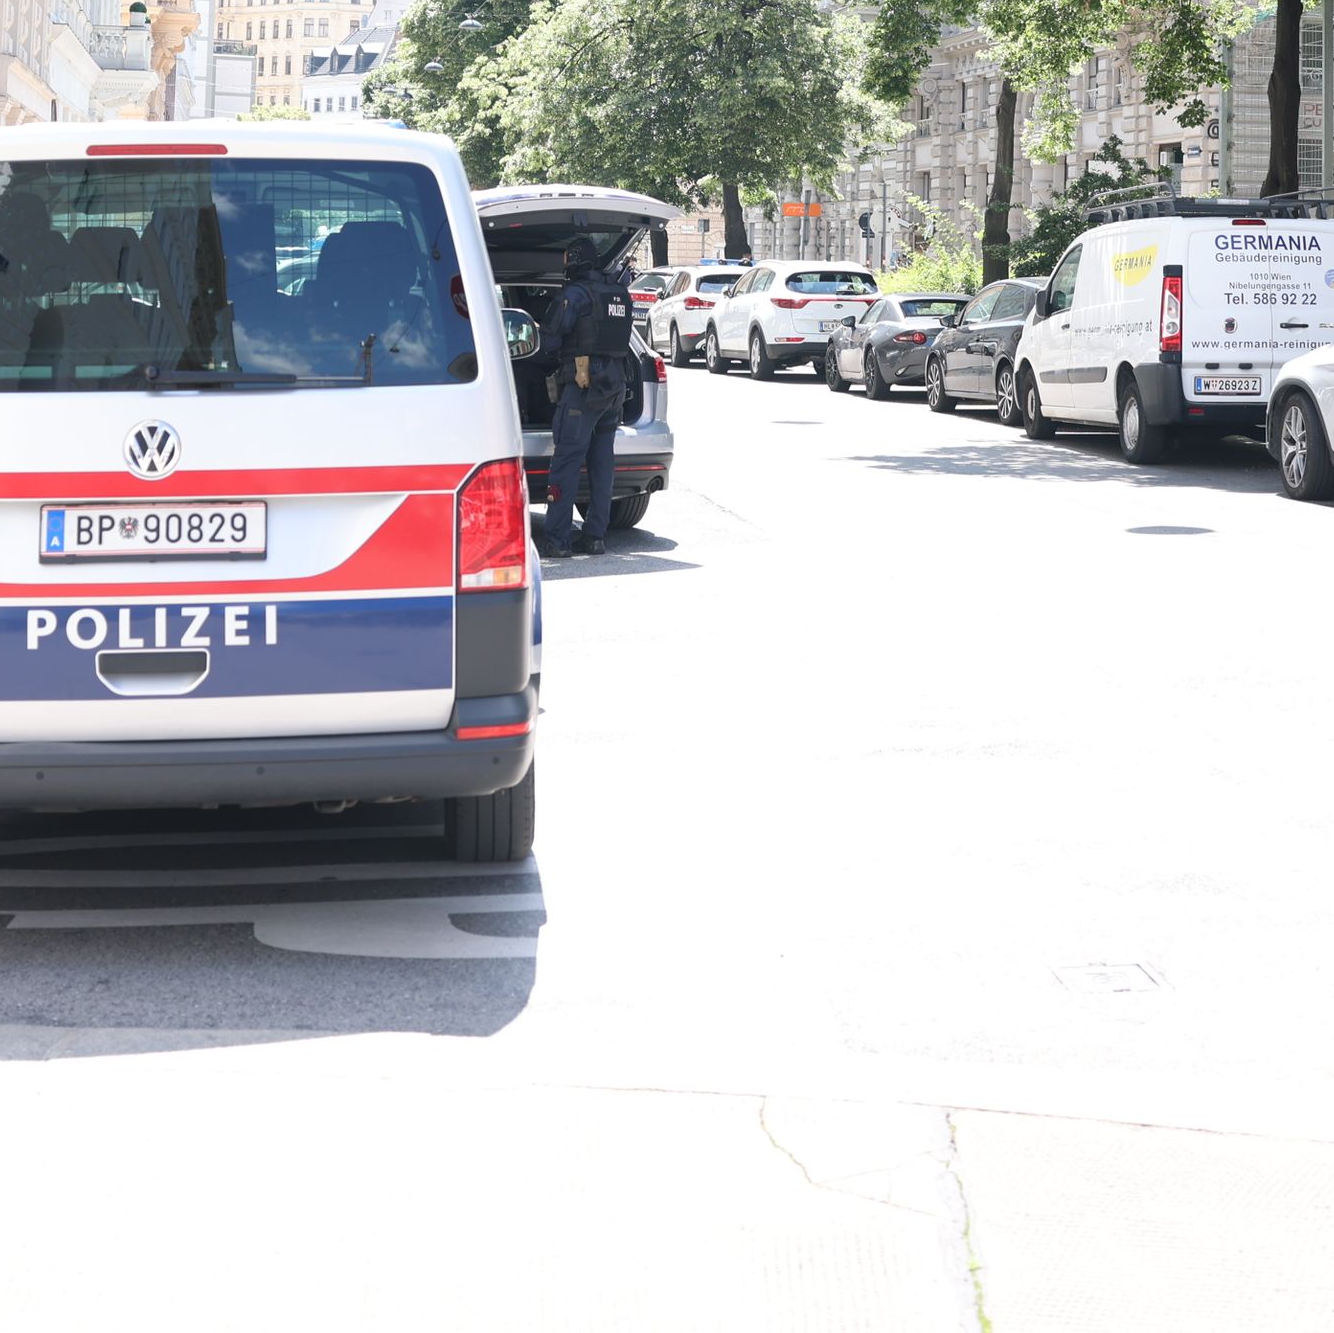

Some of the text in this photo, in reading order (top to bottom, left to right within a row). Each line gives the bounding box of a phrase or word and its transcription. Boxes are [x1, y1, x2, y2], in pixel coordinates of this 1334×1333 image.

[1214, 234, 1322, 251] GERMANIA
[1114, 255, 1152, 272] GERMANIA
[1215, 252, 1323, 266] Gebäudereinigung
[1249, 273, 1292, 281] 1010 Wien
[1229, 282, 1312, 291] Nibelungengasse 11
[1224, 292, 1318, 305] Tel. 586 92 22
[608, 303, 626, 317] POLIZEI
[1203, 380, 1257, 390] W 26923 Z
[77, 513, 247, 546] BP 90829
[50, 536, 60, 547] A
[26, 604, 277, 650] POLIZEI
